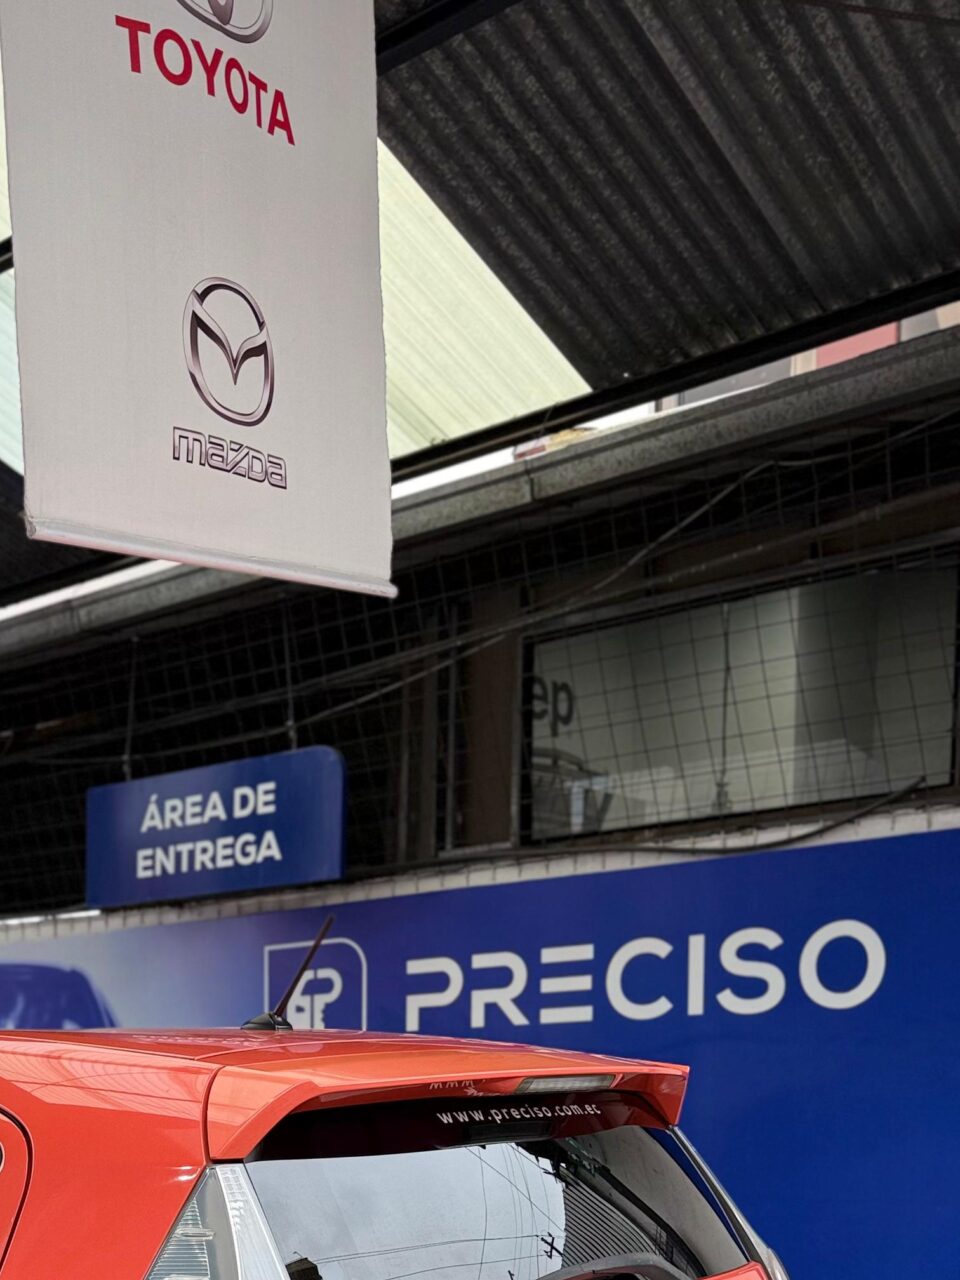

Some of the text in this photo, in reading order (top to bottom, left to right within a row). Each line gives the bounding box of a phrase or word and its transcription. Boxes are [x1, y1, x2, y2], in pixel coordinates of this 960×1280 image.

[115, 15, 296, 146] TOYOTA
[141, 781, 276, 833] ÁREA DE
[136, 830, 283, 879] ENTREGA
[405, 918, 887, 1032] PRECISO
[436, 1103, 602, 1124] www.preciso.com.ec
